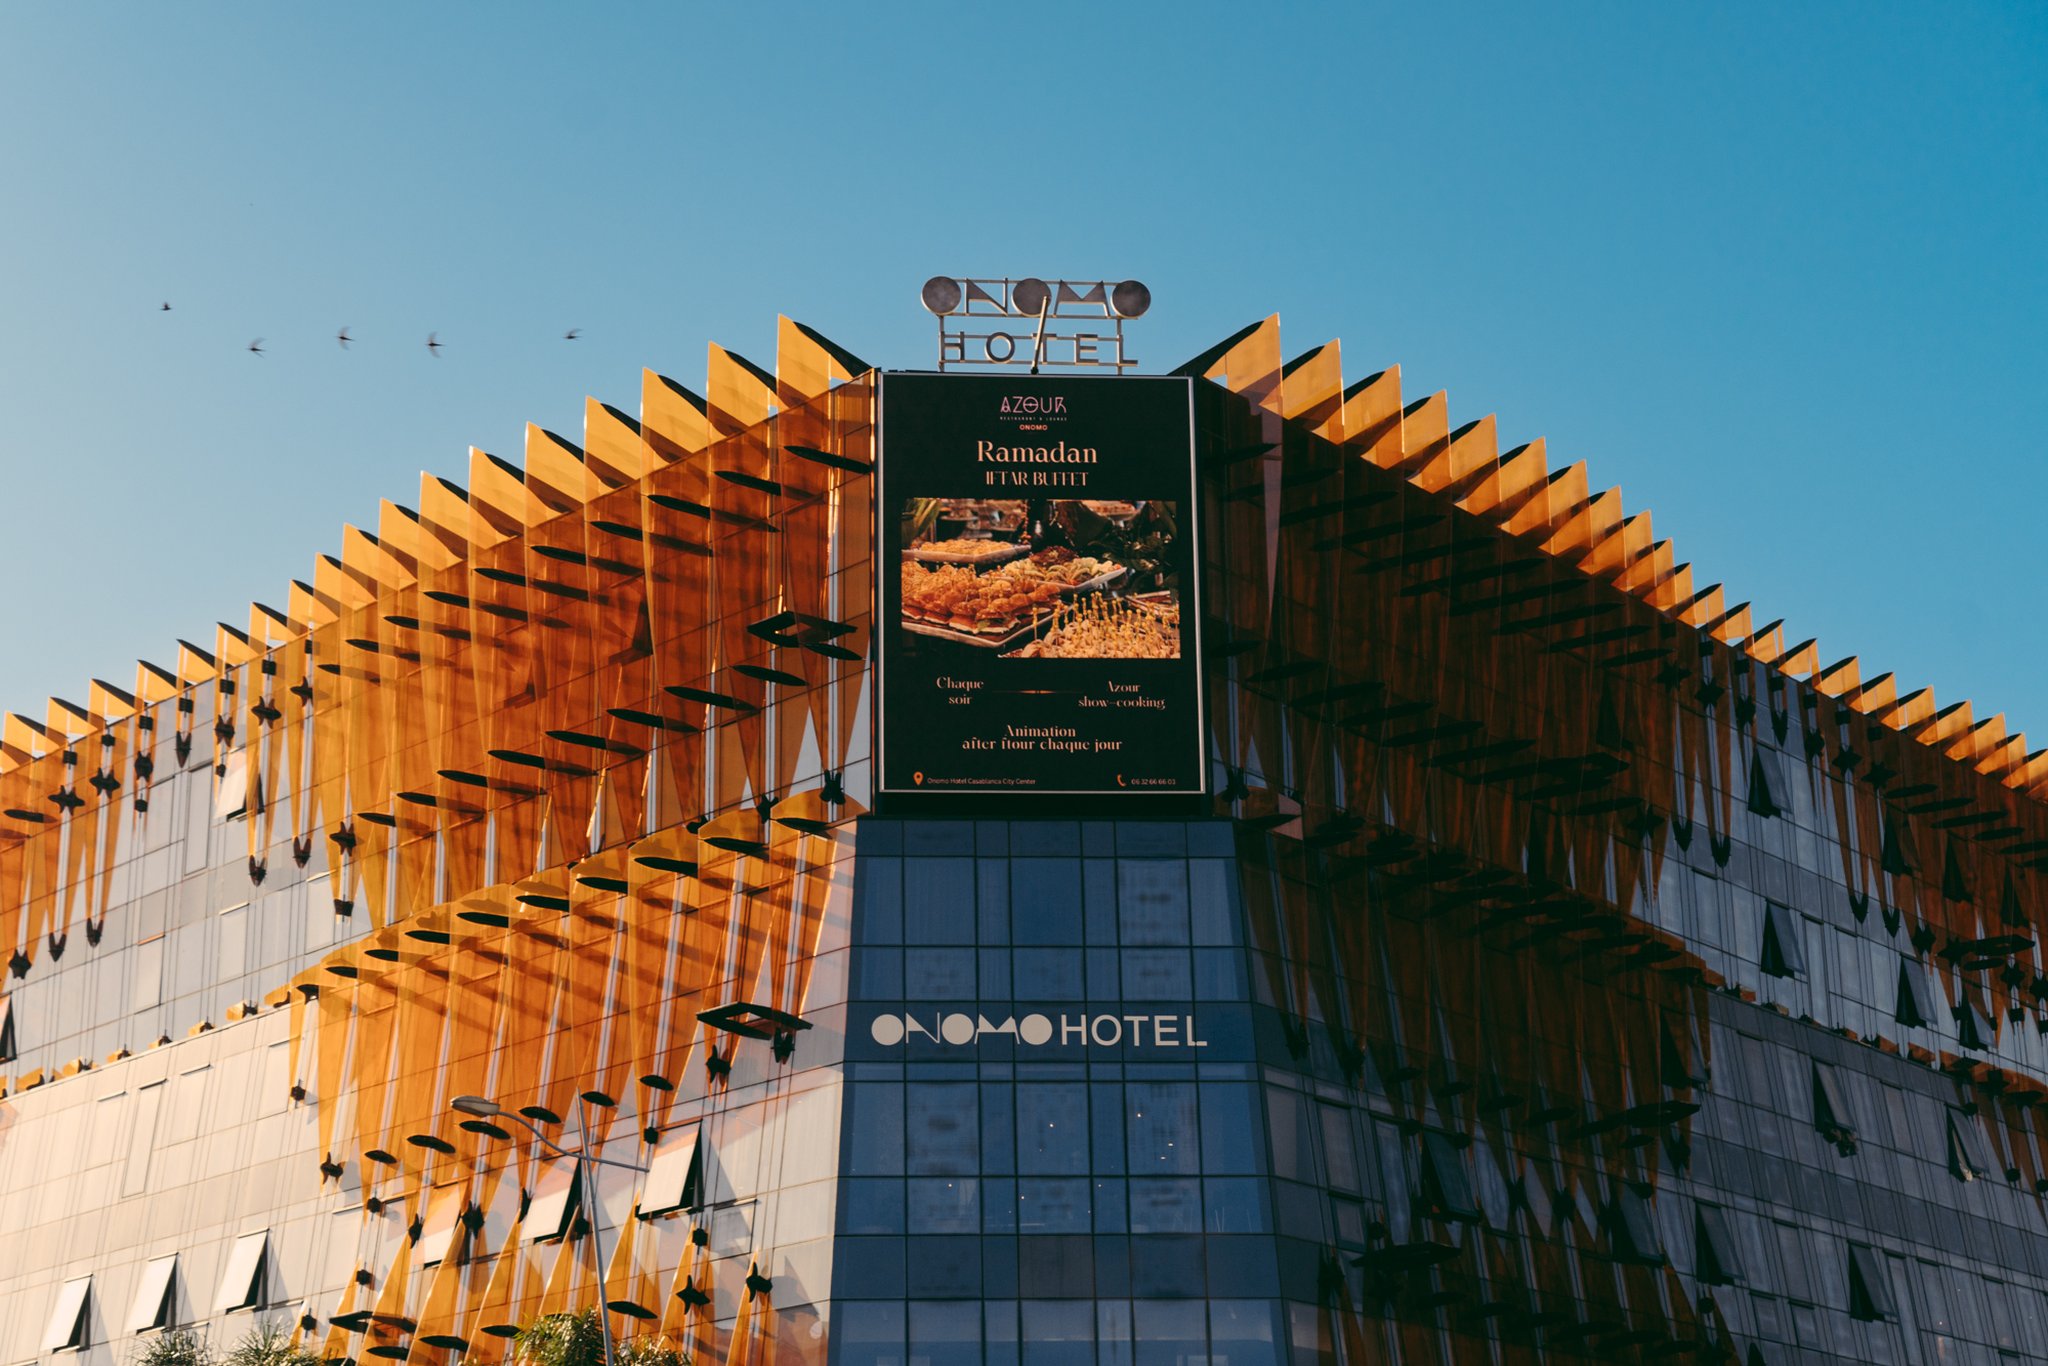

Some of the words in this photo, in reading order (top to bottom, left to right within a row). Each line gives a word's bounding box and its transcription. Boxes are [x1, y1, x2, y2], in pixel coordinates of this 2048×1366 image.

[921, 276, 1151, 318] ONOMO
[939, 331, 1139, 367] HOTEL
[1000, 396, 1067, 413] AZOUR
[977, 440, 1098, 463] Ramadan
[985, 471, 1028, 486] IFTAR
[1033, 471, 1089, 487] BUFFET
[936, 676, 984, 692] Chaque
[1107, 680, 1141, 692] Azour
[948, 694, 972, 704] soir
[1078, 695, 1166, 710] show-cooking
[1004, 724, 1076, 737] Animation
[962, 737, 996, 750] after
[1039, 738, 1090, 753] chaque
[1095, 739, 1123, 753] jour
[871, 1012, 1053, 1046] ONOMO
[1060, 1014, 1208, 1046] HOTEL
